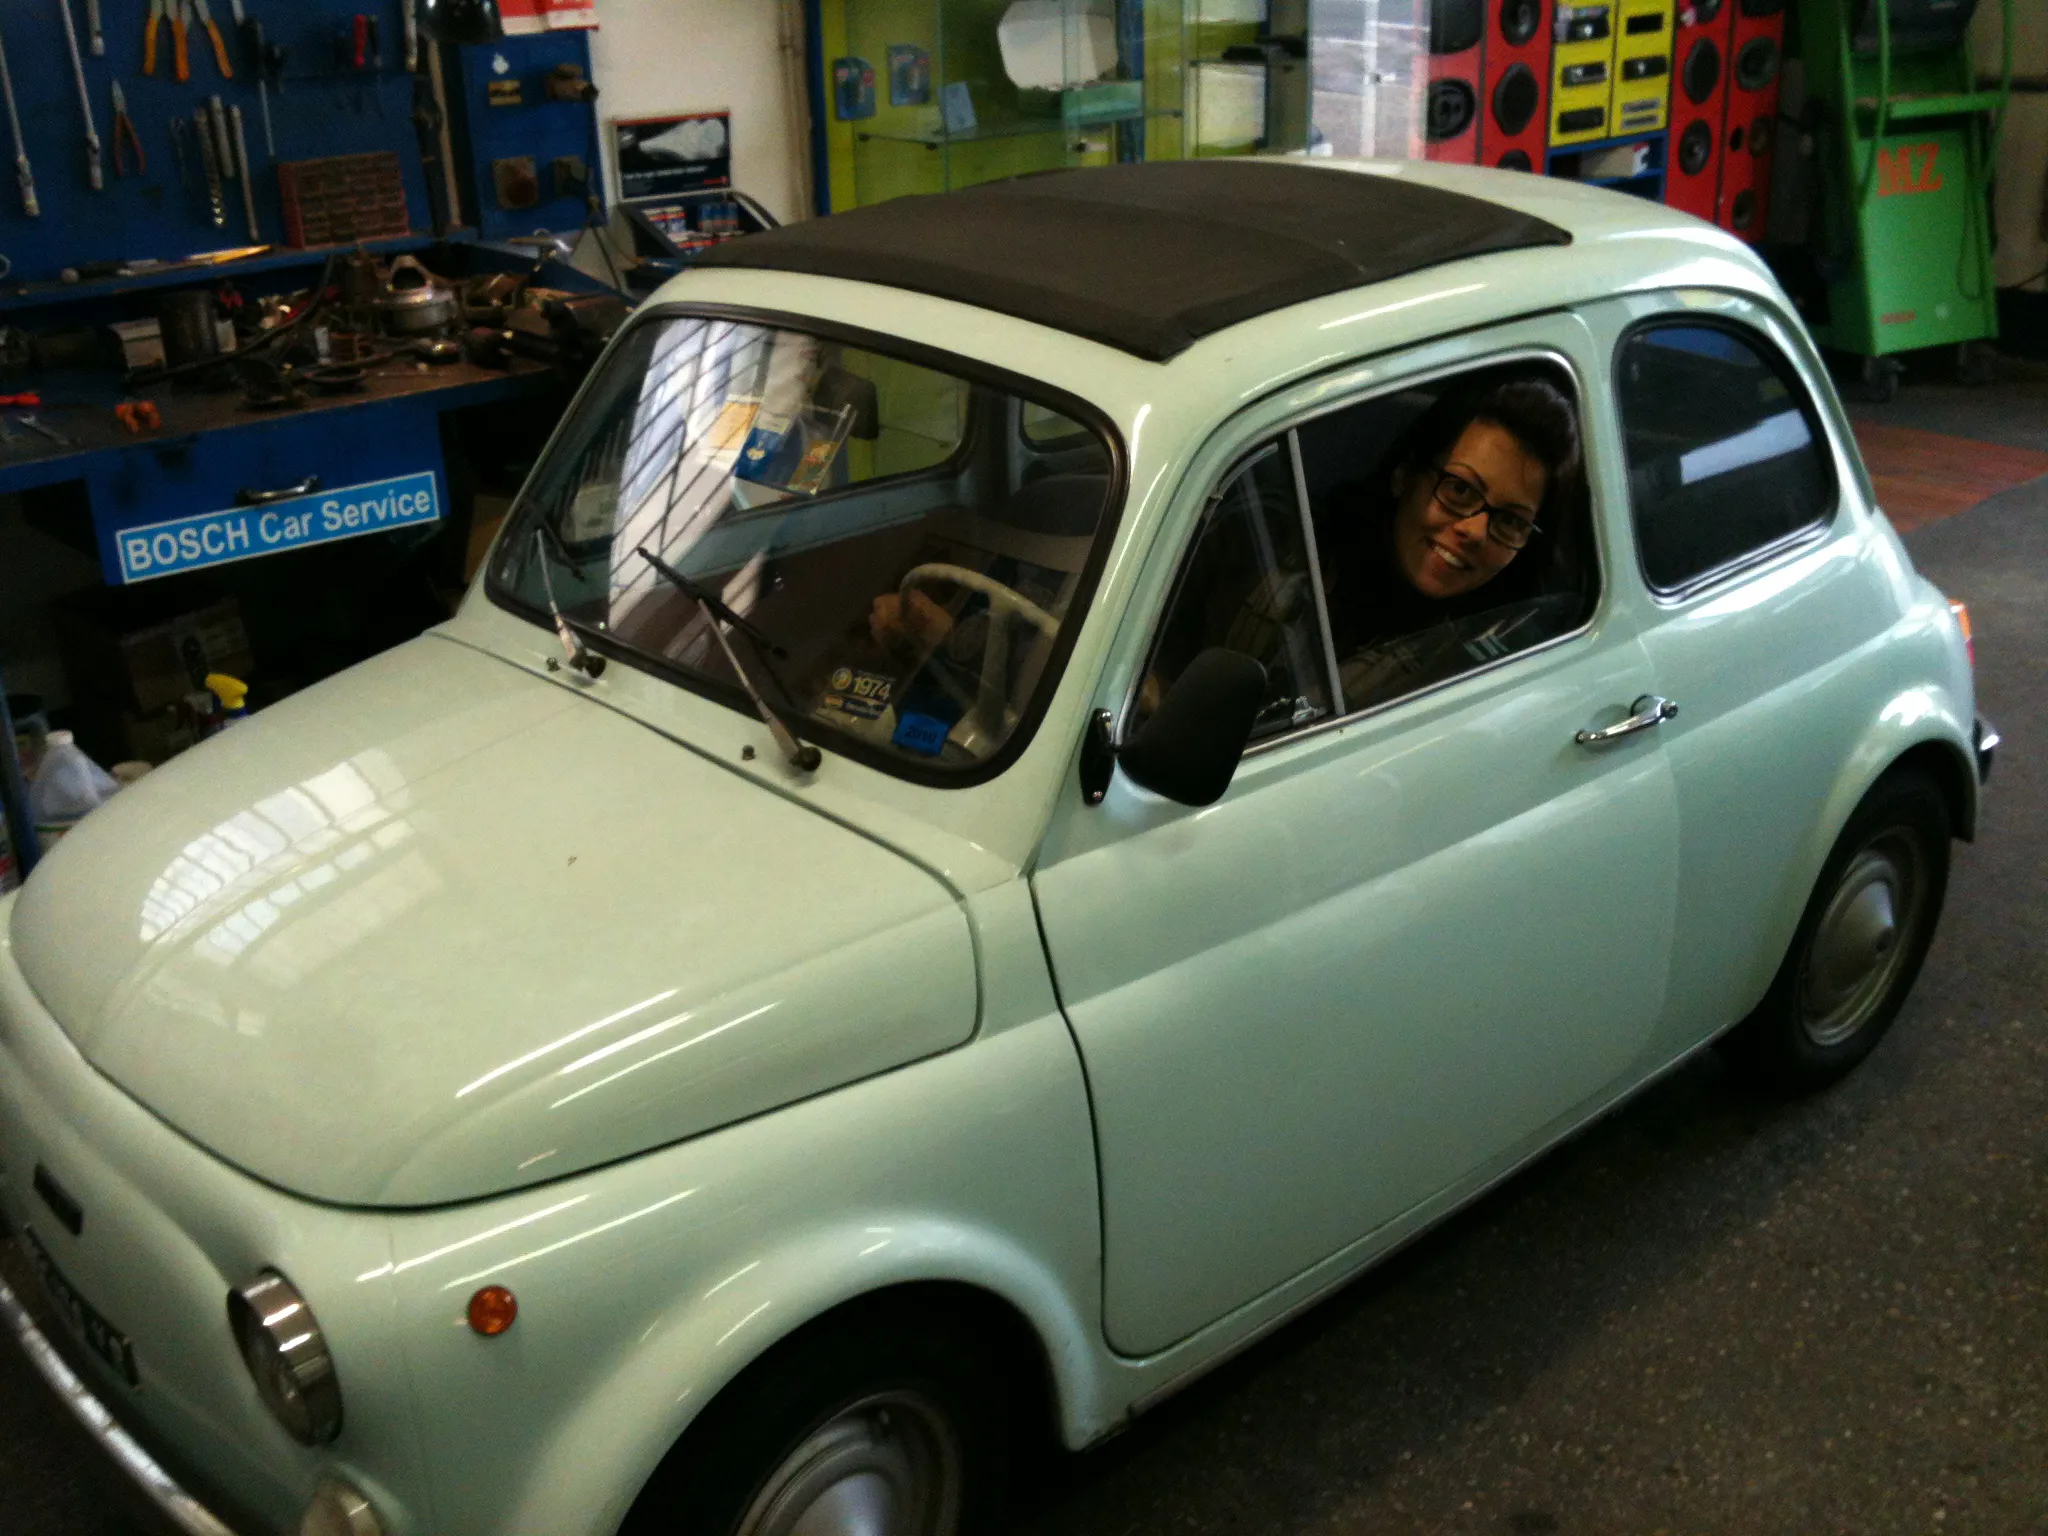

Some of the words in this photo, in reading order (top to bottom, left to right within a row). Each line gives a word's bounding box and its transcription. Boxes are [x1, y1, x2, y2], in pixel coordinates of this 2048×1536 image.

[1878, 144, 1942, 196] MZ
[126, 518, 249, 572] BOSCH
[259, 510, 313, 544] Car
[321, 489, 431, 531] Service
[852, 675, 892, 701] 1974
